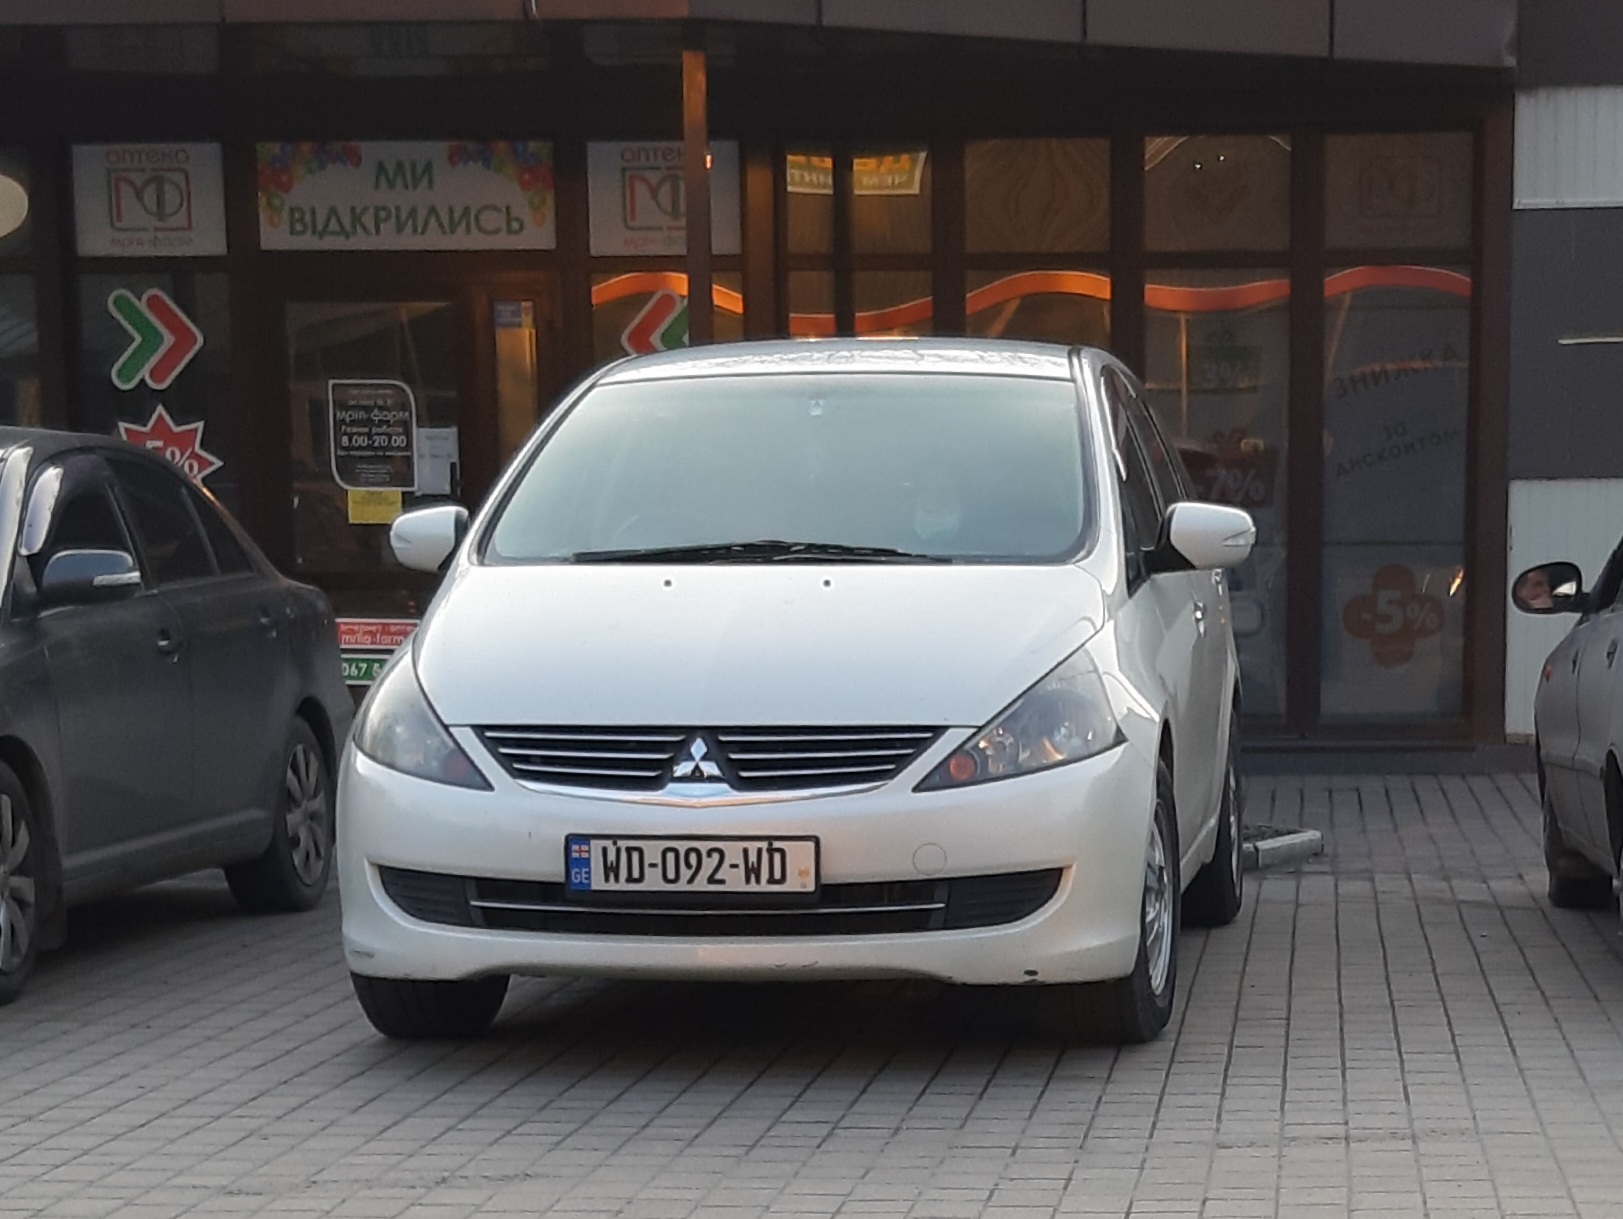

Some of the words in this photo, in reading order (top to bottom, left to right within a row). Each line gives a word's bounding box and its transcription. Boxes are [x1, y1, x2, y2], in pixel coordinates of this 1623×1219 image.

[373, 159, 435, 191] МИ
[289, 204, 525, 240] ВІДКРИЛИСЬ
[1360, 589, 1439, 635] -5%
[571, 868, 590, 884] GE
[601, 845, 788, 886] WD-092-WD
